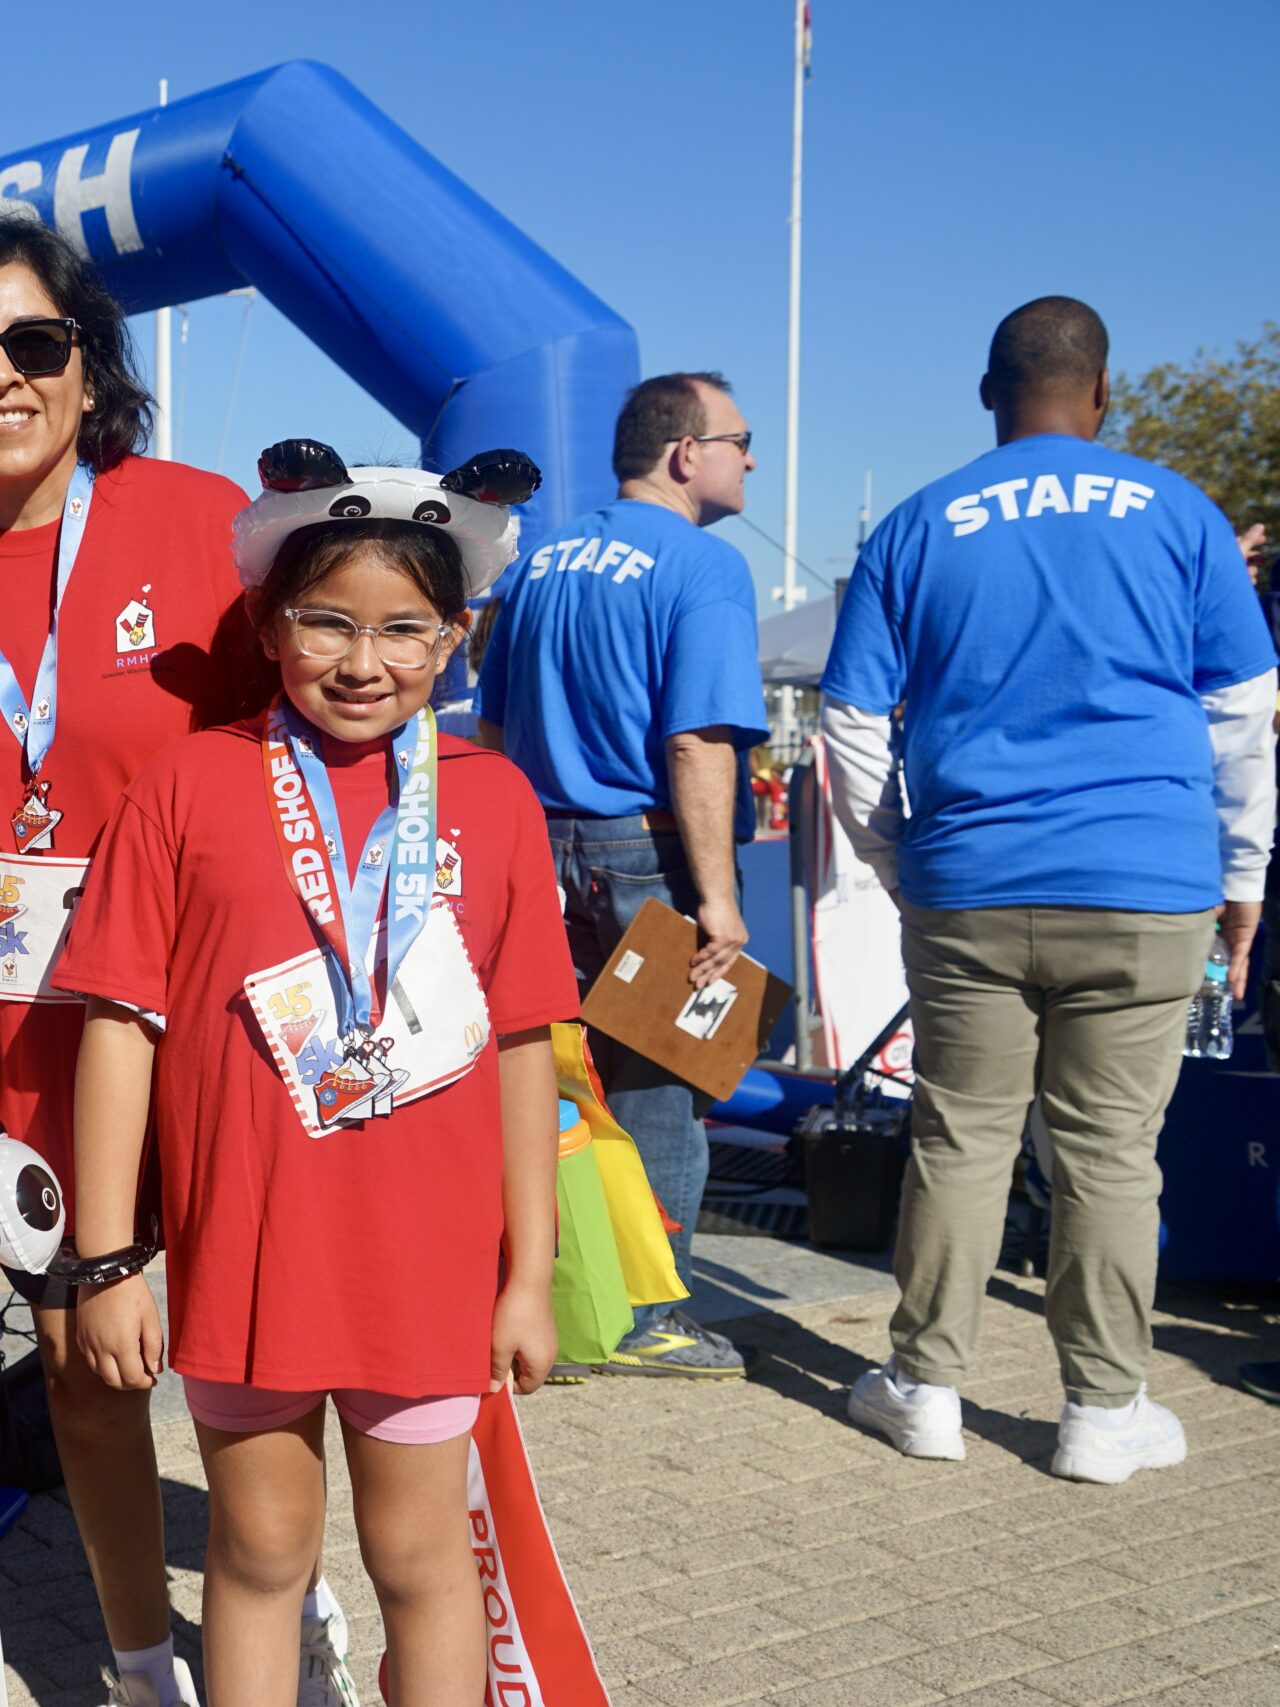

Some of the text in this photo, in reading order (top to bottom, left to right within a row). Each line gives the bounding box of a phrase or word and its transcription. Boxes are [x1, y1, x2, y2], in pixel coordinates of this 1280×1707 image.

[945, 473, 1156, 538] STAFF
[529, 537, 656, 585] STAFF
[270, 755, 316, 844] SHOE
[397, 772, 430, 865] SHOE
[291, 847, 336, 926] RED
[395, 873, 428, 923] 5K
[295, 1035, 345, 1086] 5K
